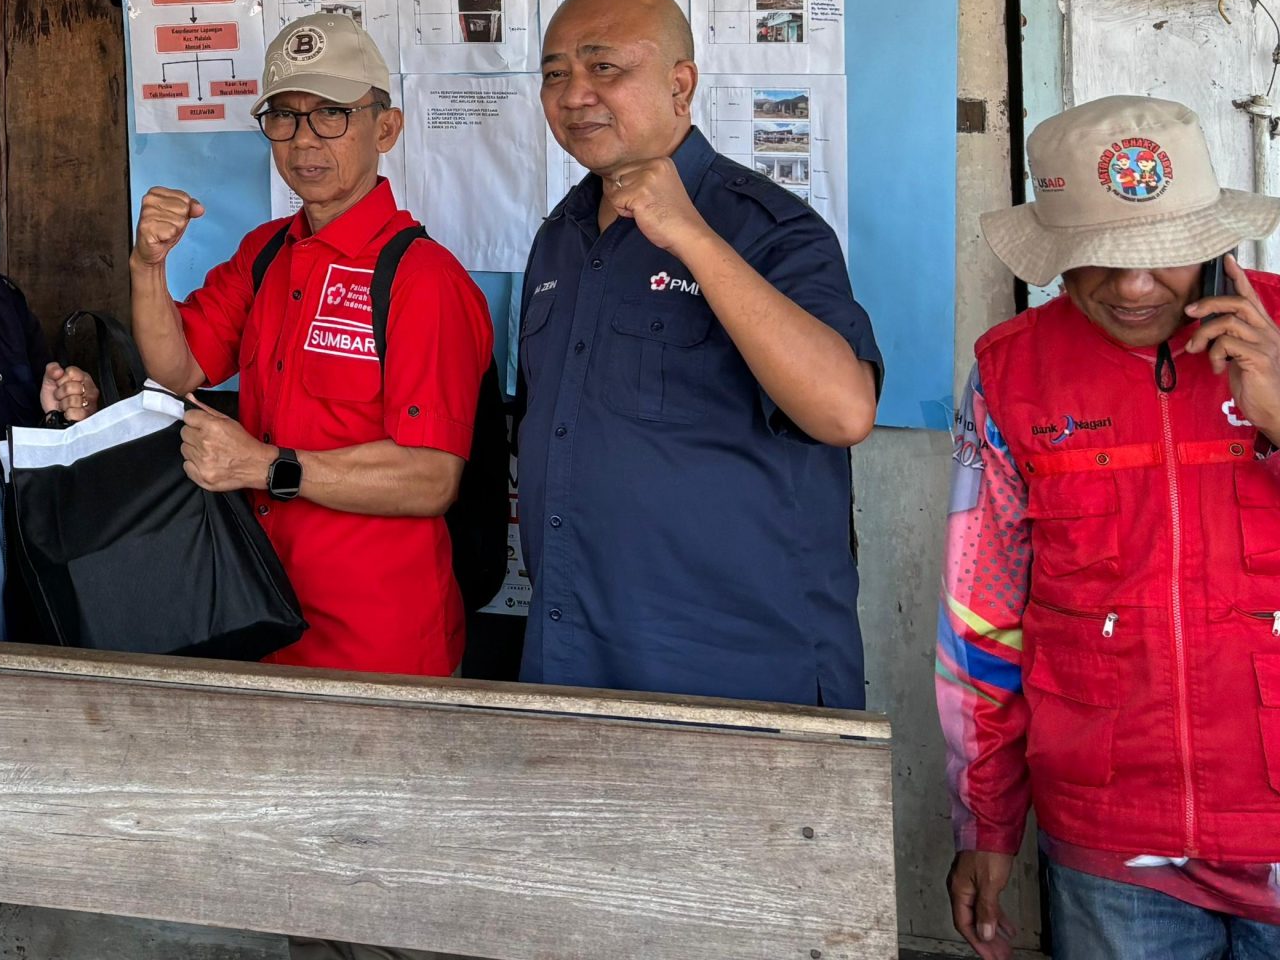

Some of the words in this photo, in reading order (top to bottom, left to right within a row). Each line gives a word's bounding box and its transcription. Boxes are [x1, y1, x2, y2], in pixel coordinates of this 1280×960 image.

[293, 34, 314, 54] B
[1037, 176, 1066, 188] USAID
[346, 291, 368, 302] Merah
[343, 300, 373, 312] Indones
[311, 329, 376, 354] SUMBAR
[1031, 423, 1059, 436] Bank
[1073, 416, 1112, 431] Nagari
